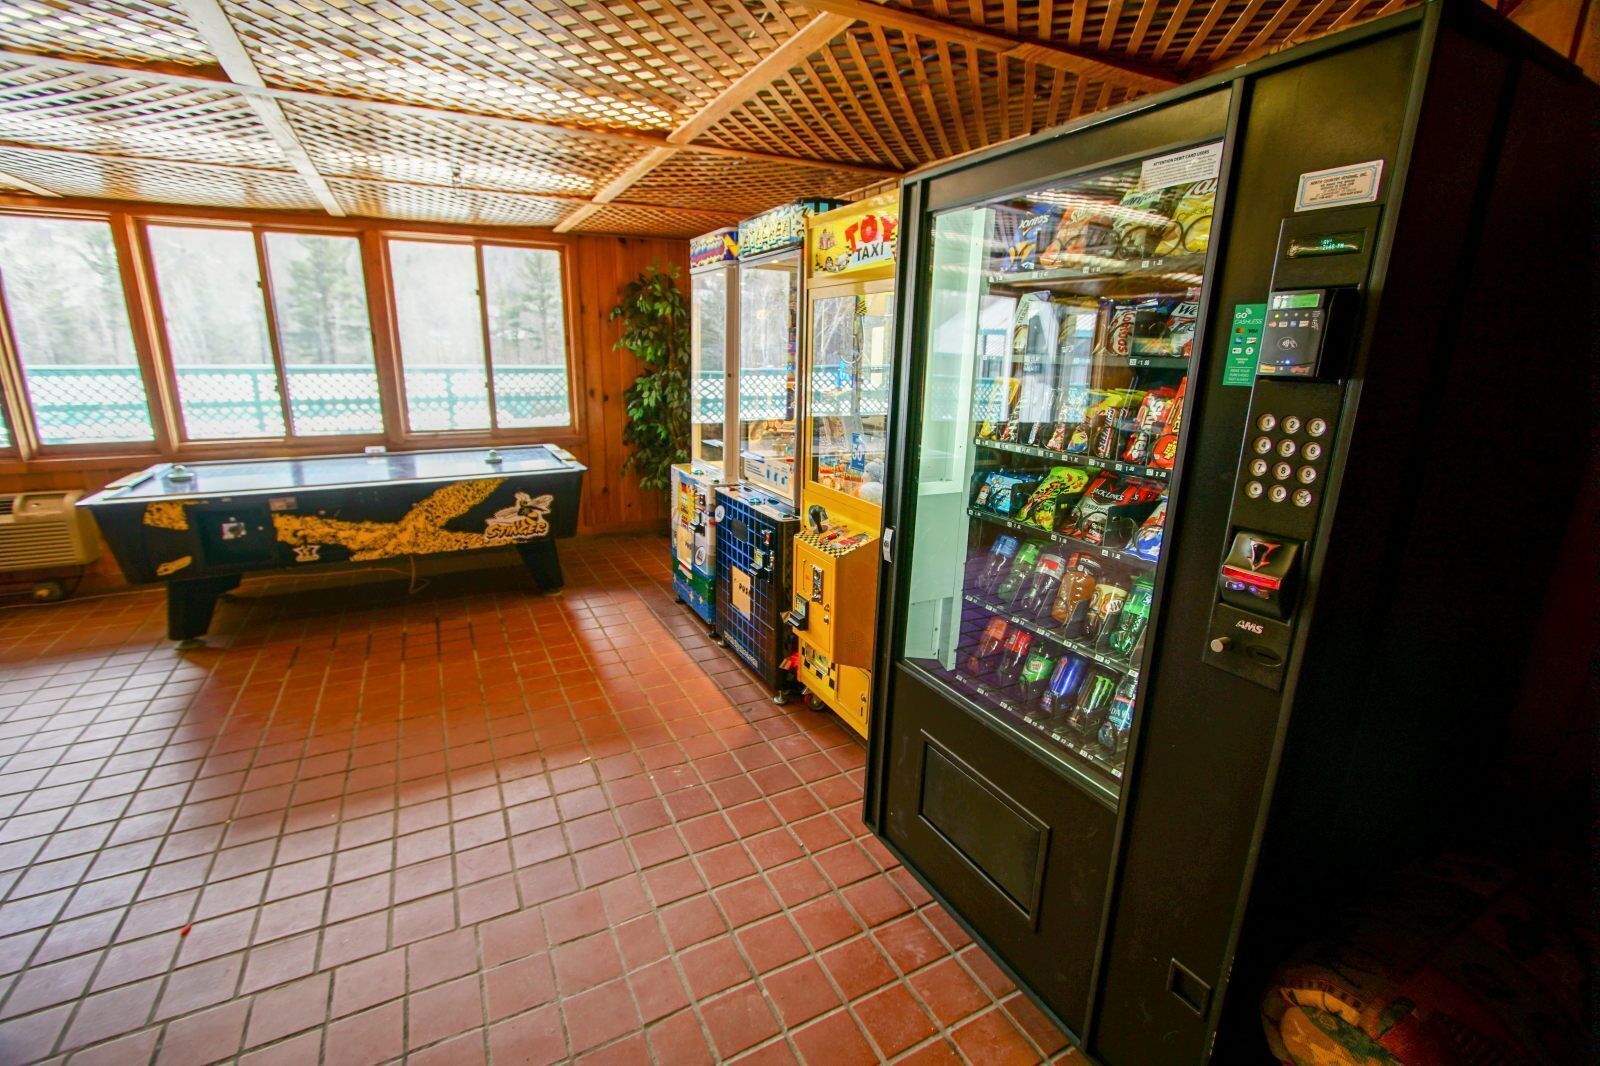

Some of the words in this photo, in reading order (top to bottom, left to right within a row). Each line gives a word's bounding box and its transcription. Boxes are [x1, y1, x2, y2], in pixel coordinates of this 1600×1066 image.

[1153, 158, 1174, 167] ATTENTION
[1174, 155, 1185, 163] DEBIT
[1185, 151, 1197, 159] CARD
[845, 214, 898, 254] TOY
[855, 242, 884, 262] TAXI
[1117, 311, 1137, 353] Combos
[1289, 420, 1295, 429] 2
[1314, 422, 1320, 431] 3
[1285, 443, 1291, 452] 5
[1310, 446, 1316, 455] 6
[1257, 463, 1263, 471] 7
[1280, 466, 1287, 475] 8
[1305, 470, 1312, 478] 9
[1090, 487, 1106, 497] JACK
[1276, 489, 1282, 497] 0
[486, 519, 547, 539] STINGER
[1235, 620, 1264, 635] AMS
